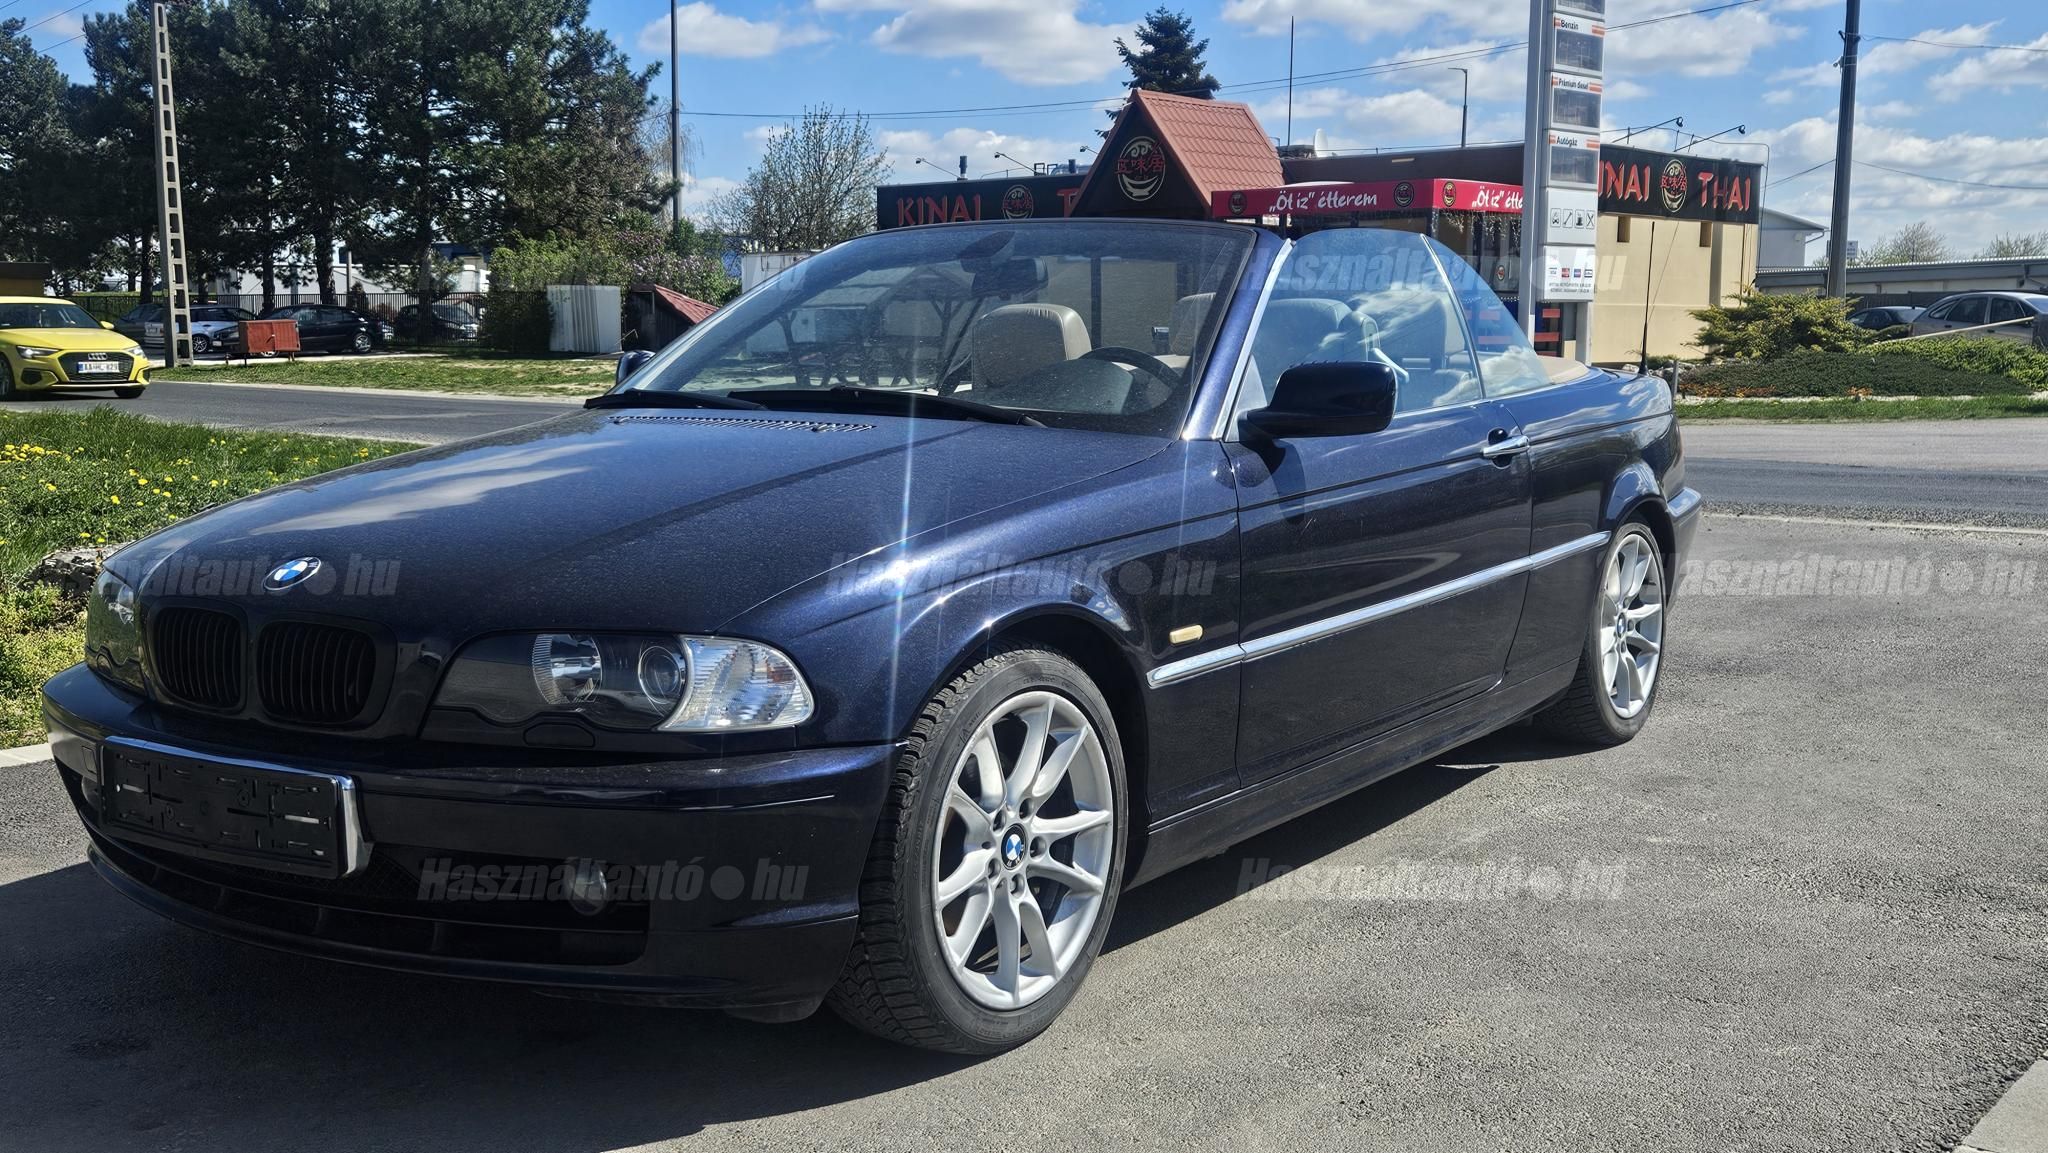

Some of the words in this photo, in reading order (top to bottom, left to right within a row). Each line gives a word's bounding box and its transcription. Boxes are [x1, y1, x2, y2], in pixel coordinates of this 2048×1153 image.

[1560, 19, 1579, 30] Benzin
[1597, 160, 1651, 202] INAI
[1697, 171, 1751, 211] THAI
[1317, 190, 1378, 209] étterem
